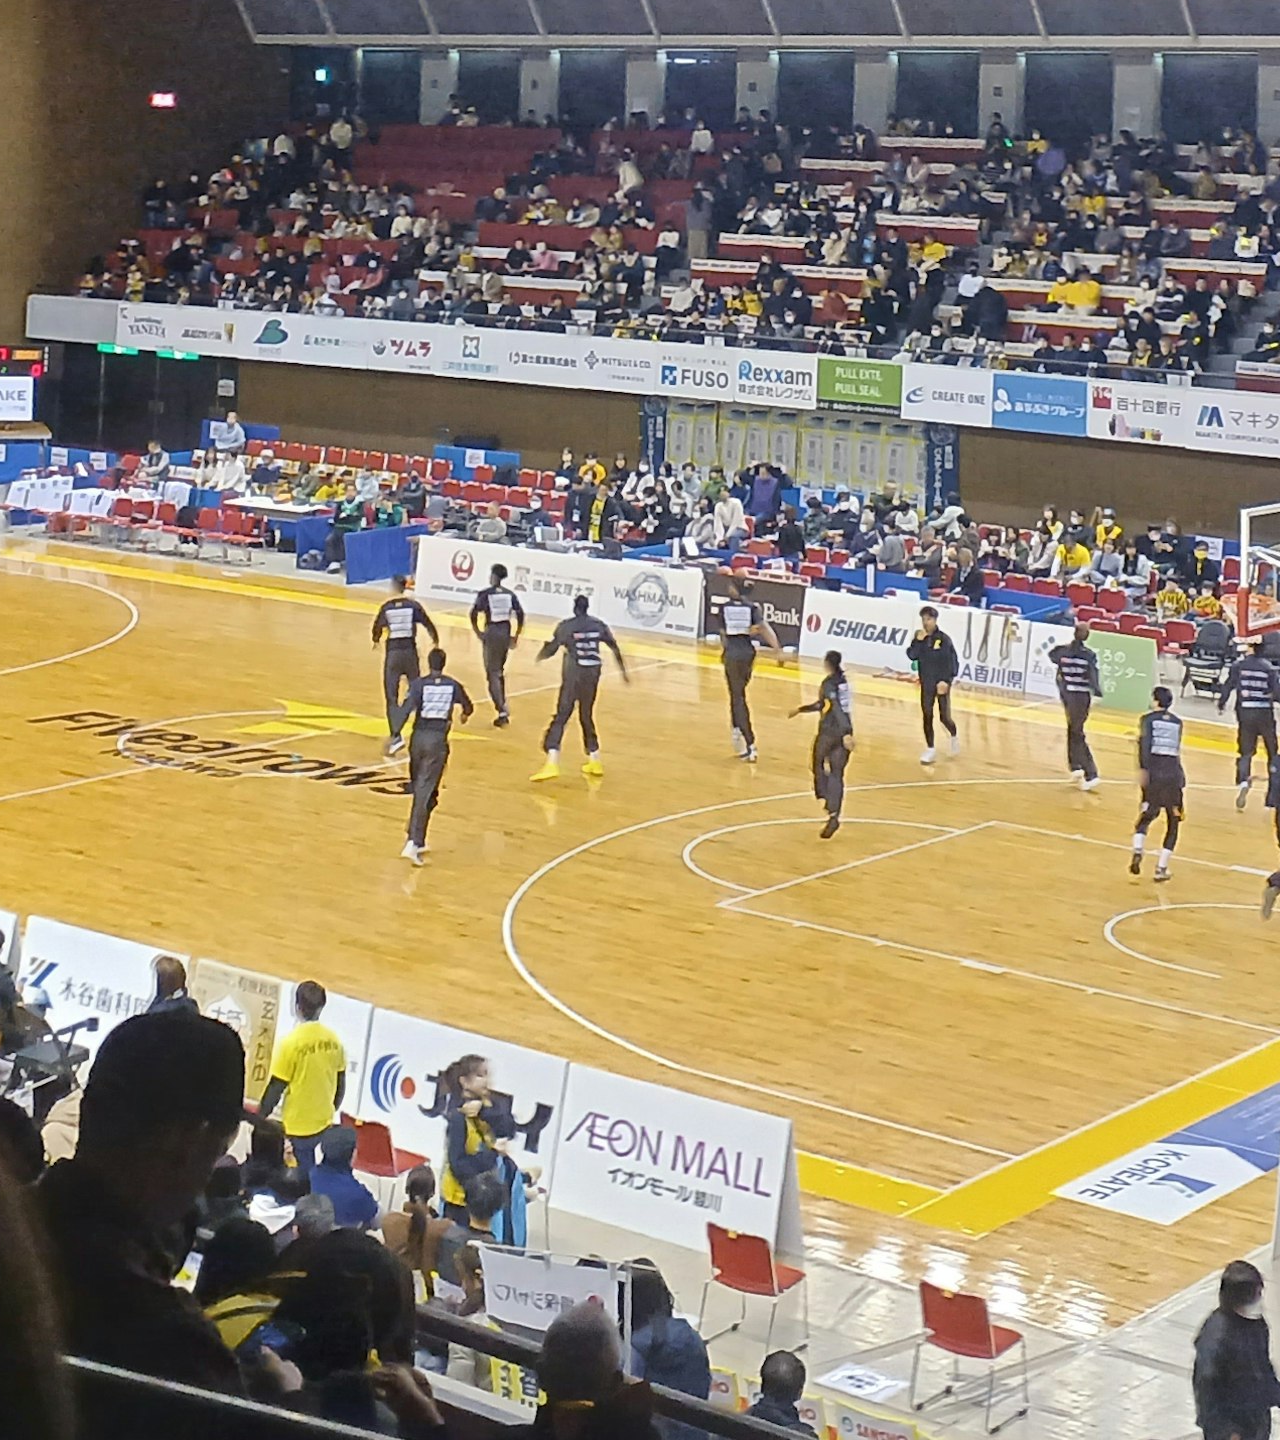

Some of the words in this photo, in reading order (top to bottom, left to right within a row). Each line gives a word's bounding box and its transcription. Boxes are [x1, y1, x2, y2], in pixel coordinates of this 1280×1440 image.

[389, 339, 431, 357] ツムラ
[681, 369, 728, 388] FUSO
[739, 360, 812, 387] Rexxam
[739, 384, 812, 401] 株式会社レクザム
[931, 390, 964, 404] CREATE
[967, 393, 985, 405] ONE
[1116, 396, 1181, 417] 百十四銀行
[1228, 410, 1279, 429] マキタ
[613, 586, 686, 609] WASHMANIA
[827, 618, 909, 646] ISHIGAKI
[960, 663, 1022, 689] A香川県
[671, 1135, 773, 1197] MALL
[607, 1167, 723, 1213] イオンモール綾川
